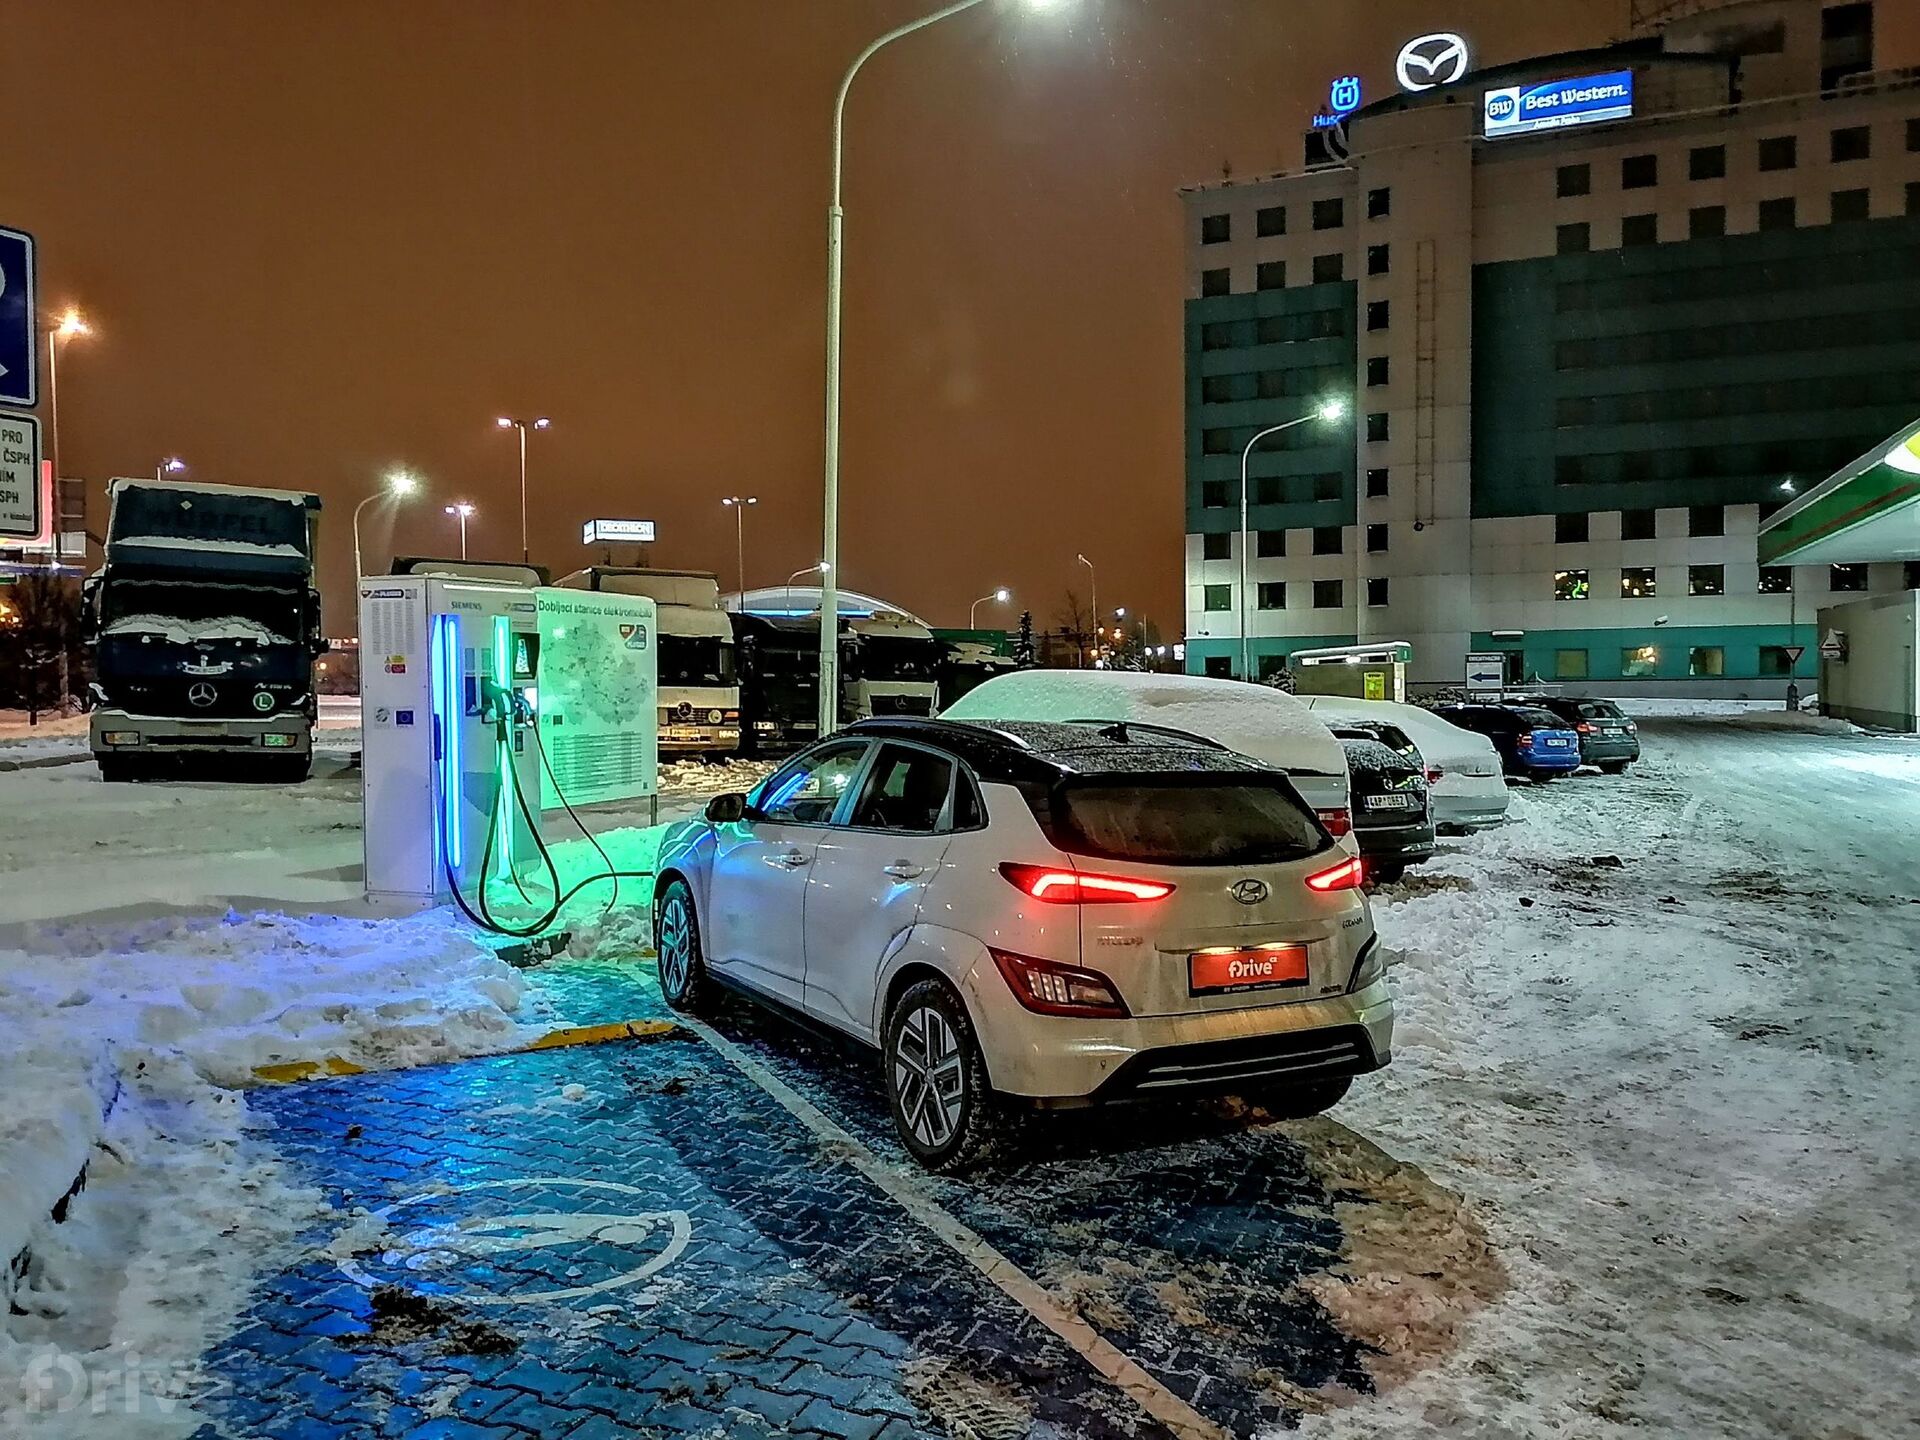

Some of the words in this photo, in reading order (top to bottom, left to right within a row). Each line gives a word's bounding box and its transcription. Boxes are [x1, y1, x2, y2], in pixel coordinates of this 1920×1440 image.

[1489, 99, 1513, 116] BW
[1525, 92, 1560, 110] Best
[2, 429, 23, 444] PRO
[3, 447, 30, 465] ČSPH
[451, 600, 482, 611] SIEMENS
